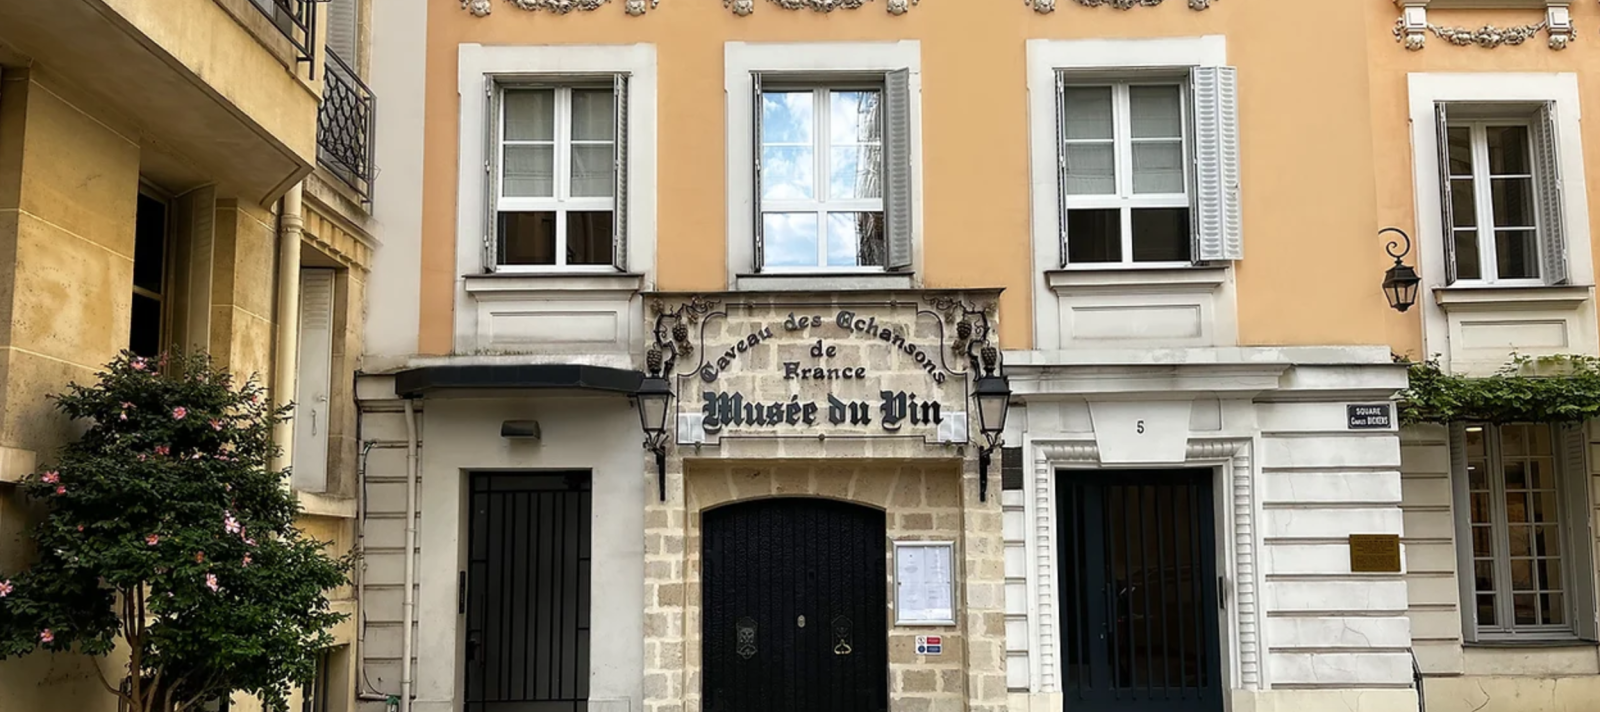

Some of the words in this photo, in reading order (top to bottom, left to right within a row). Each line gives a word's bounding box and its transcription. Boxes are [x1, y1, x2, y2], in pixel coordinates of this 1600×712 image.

[700, 327, 773, 383] Caveau
[784, 312, 821, 332] des
[836, 310, 946, 384] Echansons
[810, 340, 837, 358] de
[783, 361, 866, 380] France
[702, 390, 819, 434] Musée
[827, 393, 873, 426] du
[880, 390, 945, 432] Vin
[1355, 407, 1382, 415] SQUARE
[1136, 420, 1145, 434] 5
[1367, 416, 1388, 425] DICKENS
